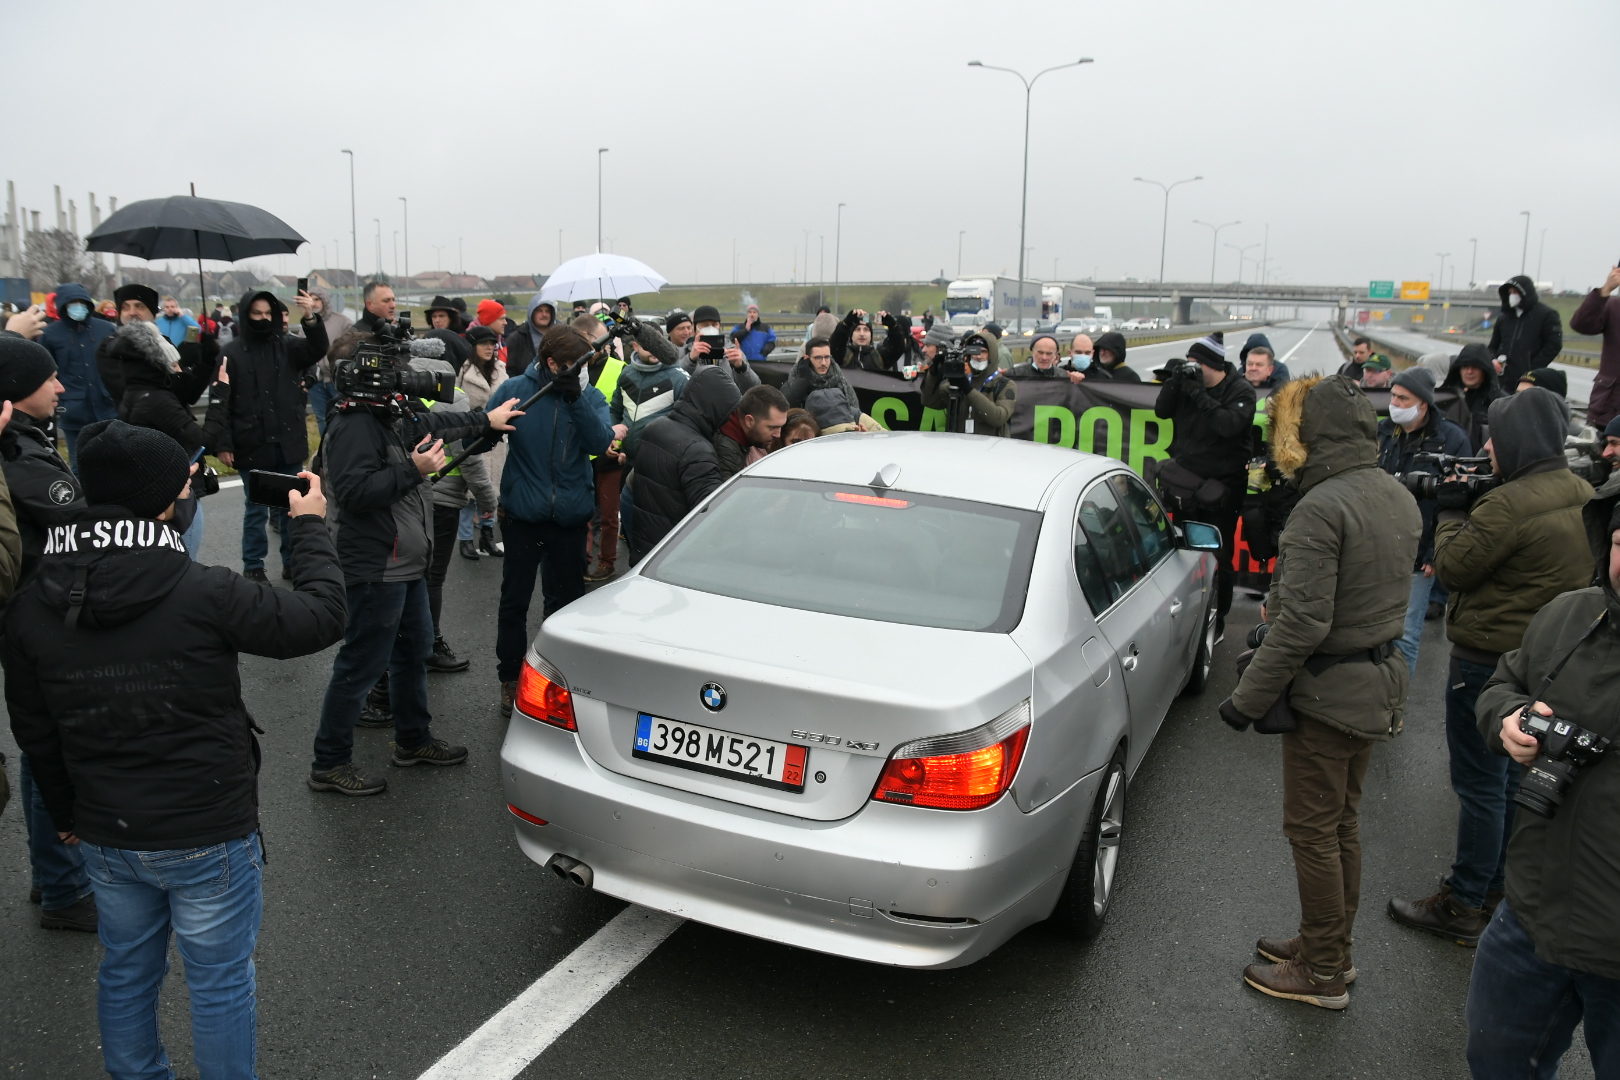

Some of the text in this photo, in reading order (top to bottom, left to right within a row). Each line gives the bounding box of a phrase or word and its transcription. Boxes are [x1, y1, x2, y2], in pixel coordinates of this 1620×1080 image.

[637, 737, 649, 747] BG
[791, 729, 841, 746] 530
[786, 770, 799, 781] 22
